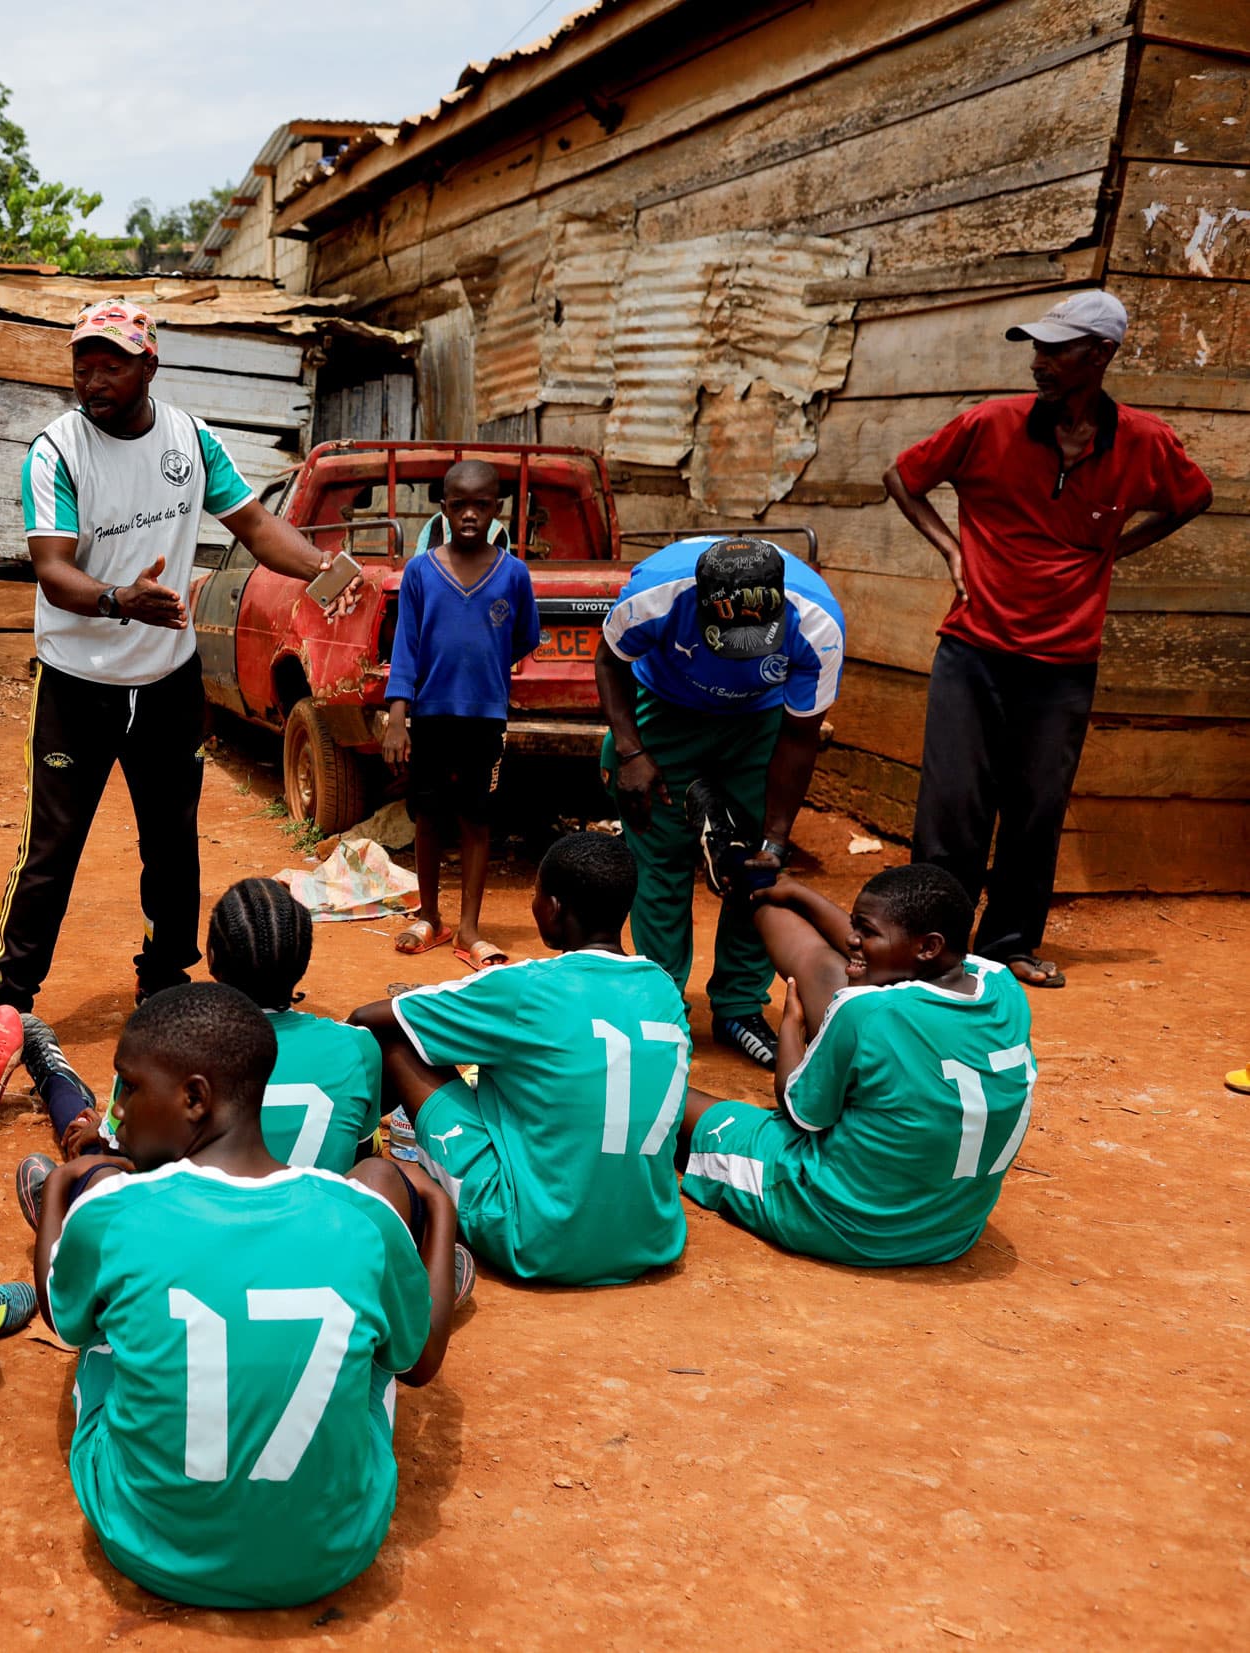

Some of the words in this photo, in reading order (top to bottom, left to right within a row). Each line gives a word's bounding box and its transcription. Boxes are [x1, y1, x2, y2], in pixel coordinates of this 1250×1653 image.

[557, 630, 592, 656] CE
[571, 603, 610, 611] TOYOTA
[592, 1019, 689, 1155] 17
[942, 1043, 1038, 1180] 17
[168, 1286, 356, 1482] 17
